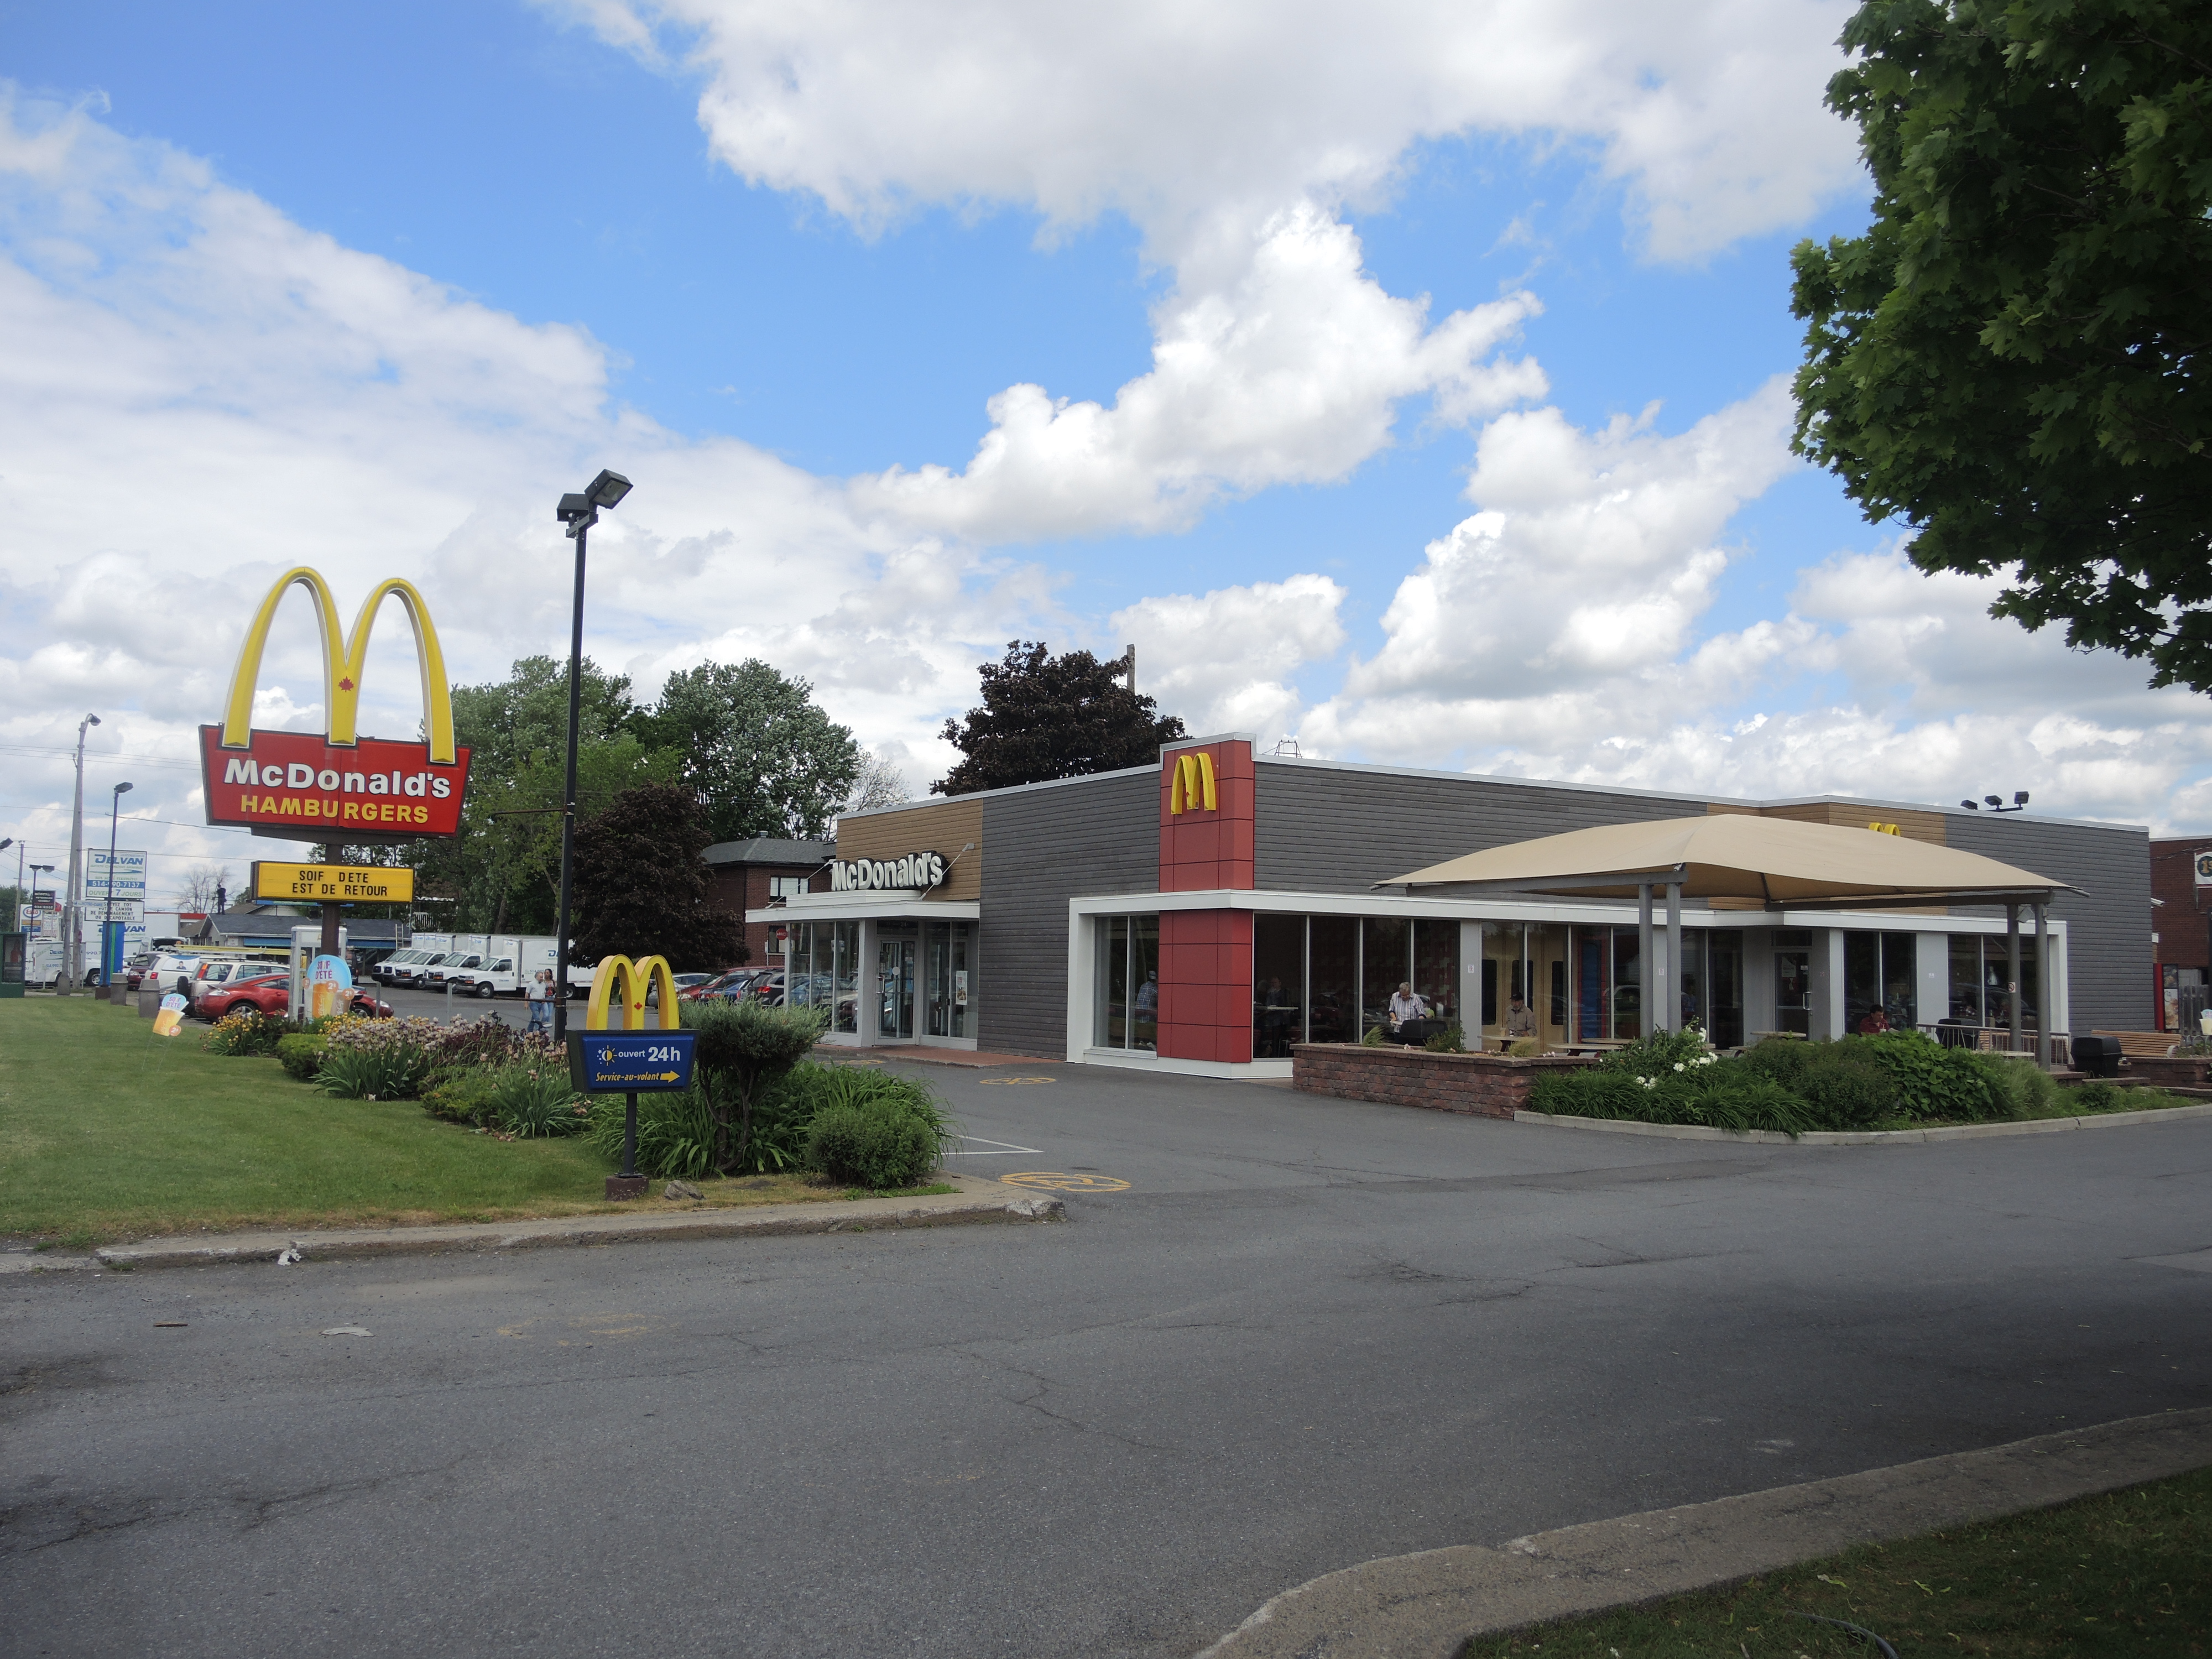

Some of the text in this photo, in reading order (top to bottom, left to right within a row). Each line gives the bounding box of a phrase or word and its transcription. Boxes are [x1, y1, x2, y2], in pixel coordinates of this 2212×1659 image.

[224, 758, 451, 798] McDonald's
[241, 795, 429, 823] HAMBURGERS
[299, 870, 369, 883] SOIF DETE
[831, 852, 943, 891] McDonald's
[293, 883, 387, 896] EST DE RETOUR
[648, 1046, 681, 1061] 24h
[596, 1071, 660, 1082] Service-au-volant
